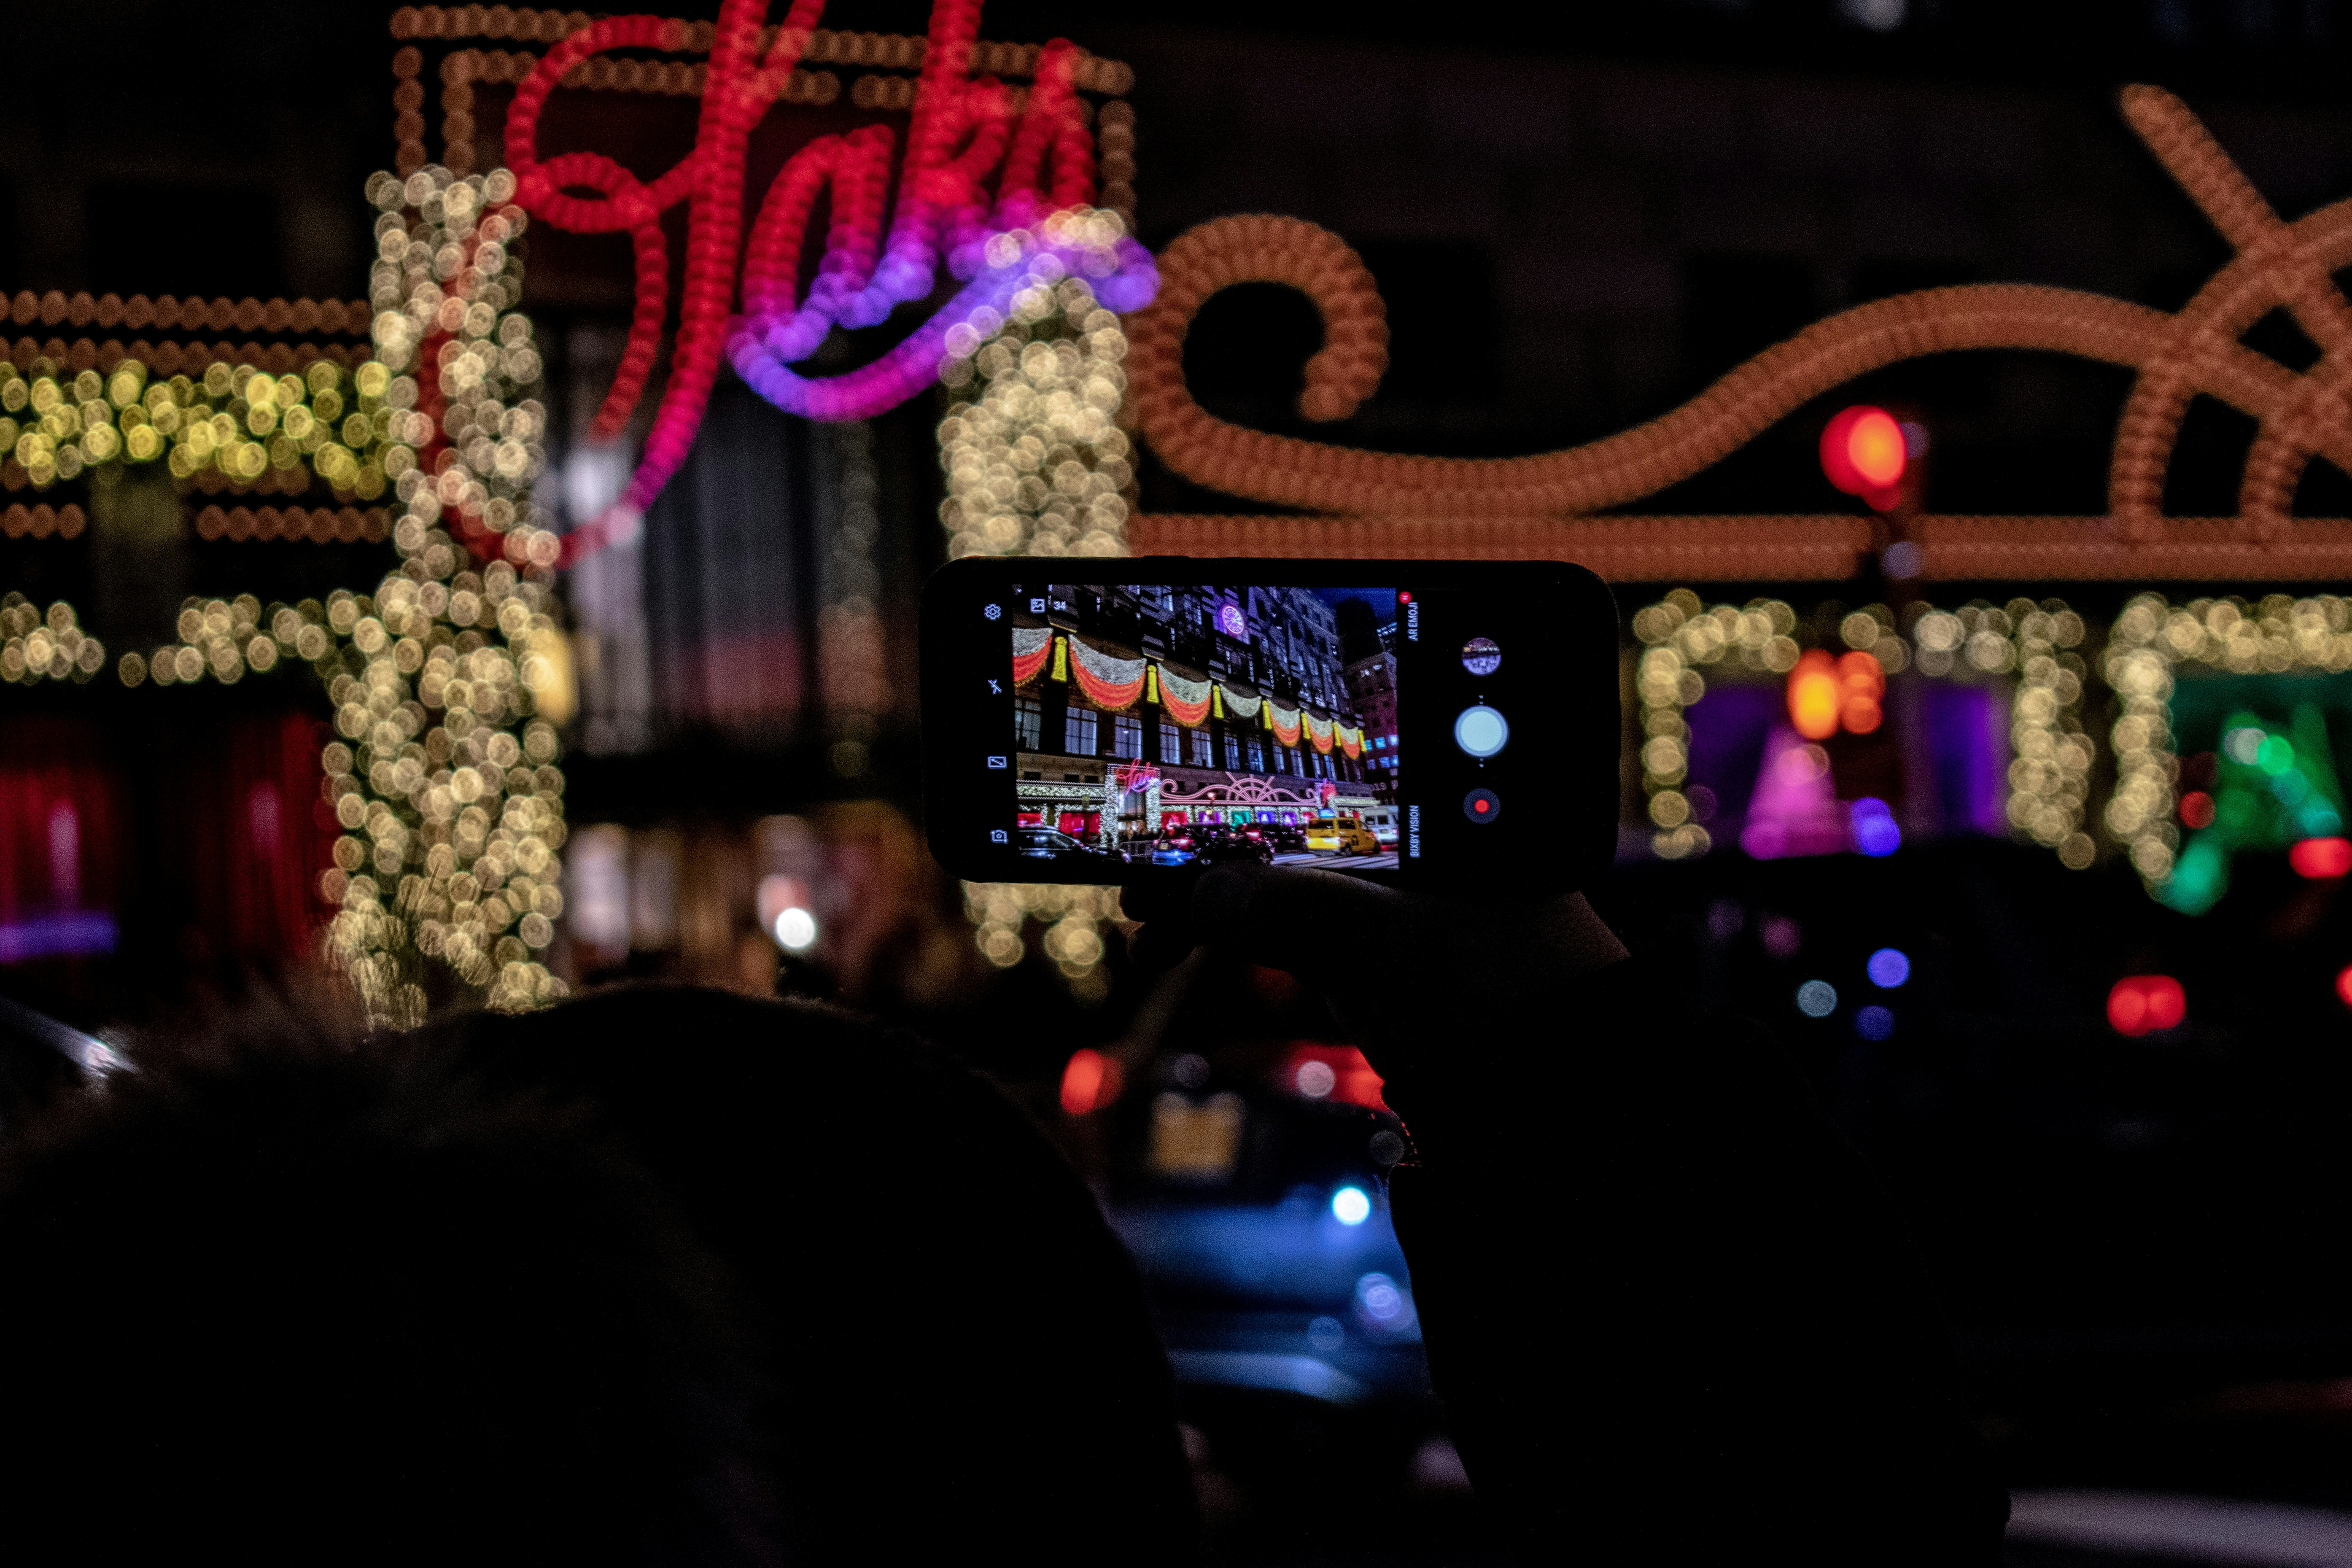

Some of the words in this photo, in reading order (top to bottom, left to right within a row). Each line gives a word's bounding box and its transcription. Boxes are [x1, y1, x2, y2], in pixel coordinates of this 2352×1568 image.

[1054, 601, 1066, 610] 34
[1408, 602, 1418, 628] EMOJI
[1408, 629, 1418, 641] AR
[1409, 805, 1419, 832] VISION
[1409, 833, 1420, 857] BIXBY
